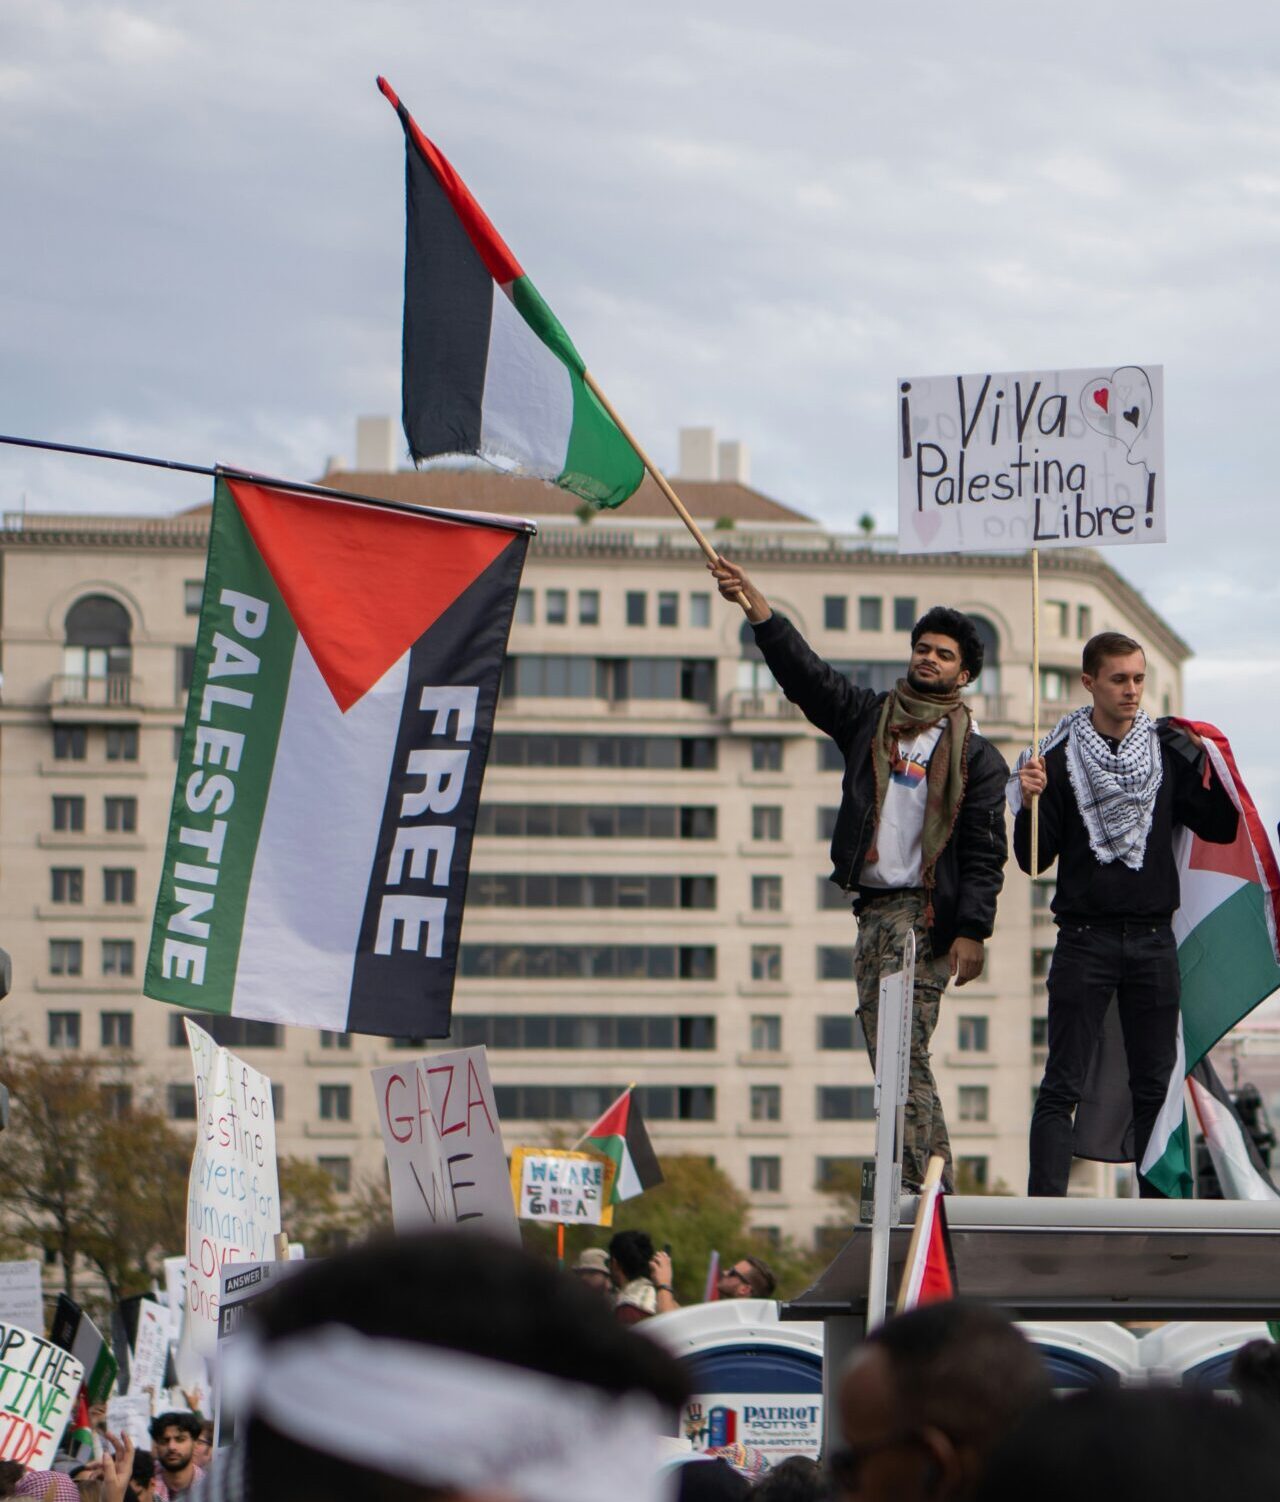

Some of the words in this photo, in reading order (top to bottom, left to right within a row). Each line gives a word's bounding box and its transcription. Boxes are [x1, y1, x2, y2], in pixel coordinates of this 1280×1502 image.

[917, 442, 1086, 512] Palestina
[162, 588, 270, 985] PALESTINE
[374, 685, 480, 958] FREE
[240, 1067, 269, 1120] for
[385, 1057, 495, 1144] GAZA
[410, 1153, 484, 1223] WE
[530, 1161, 559, 1182] WE
[567, 1166, 601, 1186] ARE
[529, 1196, 588, 1217] GAZA
[227, 1269, 260, 1292] ANSWER
[28, 1336, 75, 1392] THE
[0, 1362, 71, 1432] TINE
[743, 1406, 820, 1424] PATRIOT
[751, 1421, 809, 1429] POTTYS
